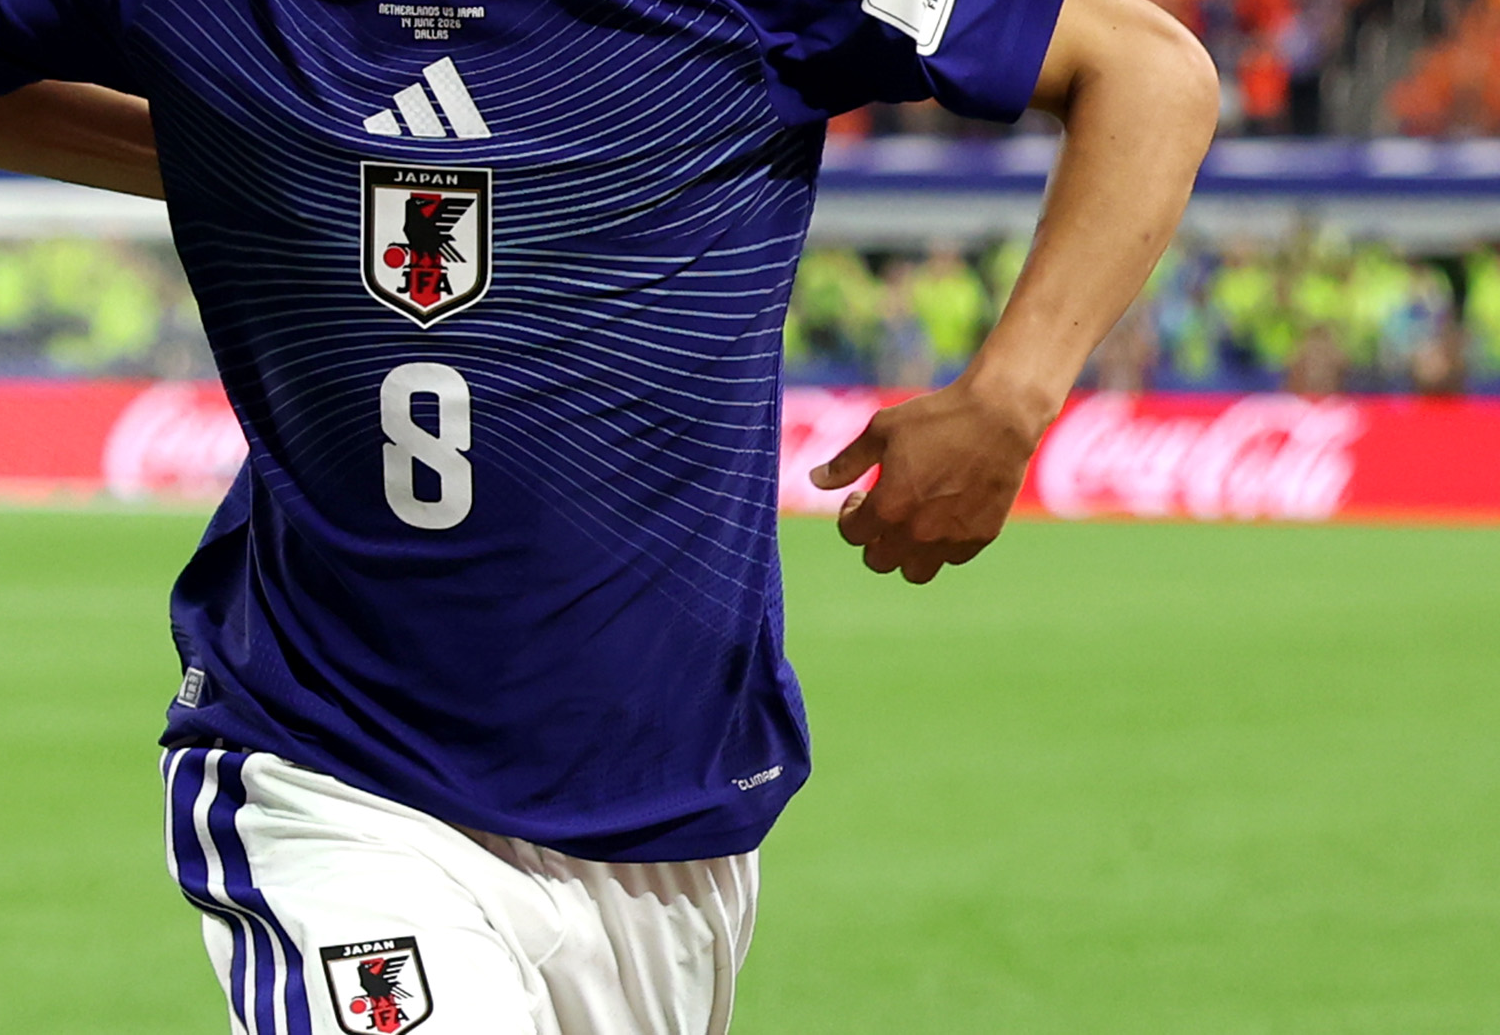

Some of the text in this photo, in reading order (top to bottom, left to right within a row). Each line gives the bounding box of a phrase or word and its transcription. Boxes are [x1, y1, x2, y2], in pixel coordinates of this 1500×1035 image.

[379, 3, 439, 16] NETHERLANDS
[457, 6, 484, 18] JAPAN
[401, 18, 461, 29] 14 JUNE 2026
[414, 29, 449, 40] DALLAS
[394, 171, 459, 185] JAPAN
[396, 271, 454, 295] JFA
[380, 362, 473, 530] 8
[343, 940, 395, 957] JAPAN
[366, 1007, 410, 1030] JFA
